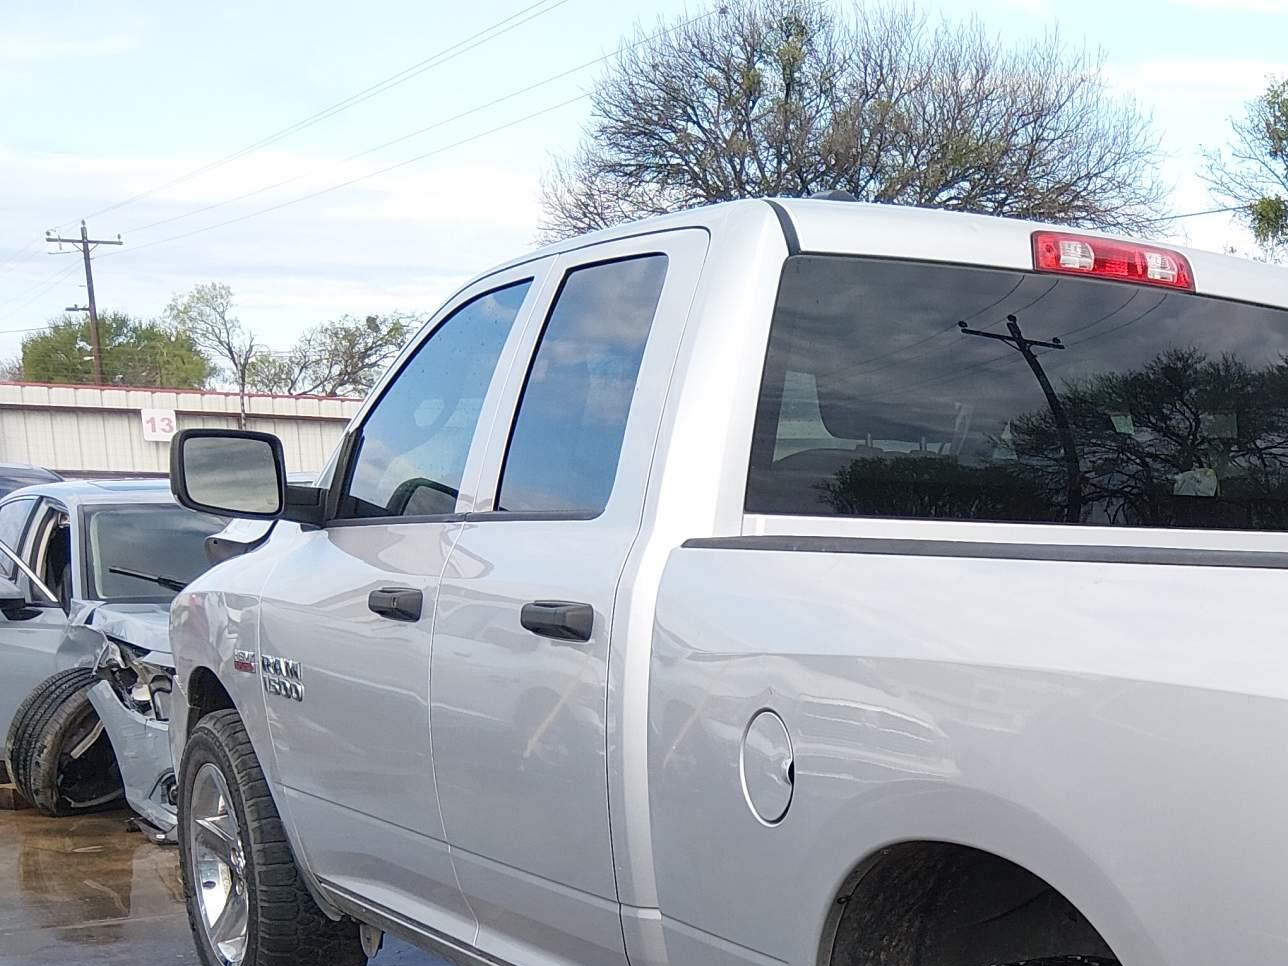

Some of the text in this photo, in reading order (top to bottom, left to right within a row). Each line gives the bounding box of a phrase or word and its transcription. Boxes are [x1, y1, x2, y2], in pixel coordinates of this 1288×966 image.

[146, 416, 174, 433] 13
[261, 654, 303, 681] RAM
[262, 674, 304, 702] 1500
